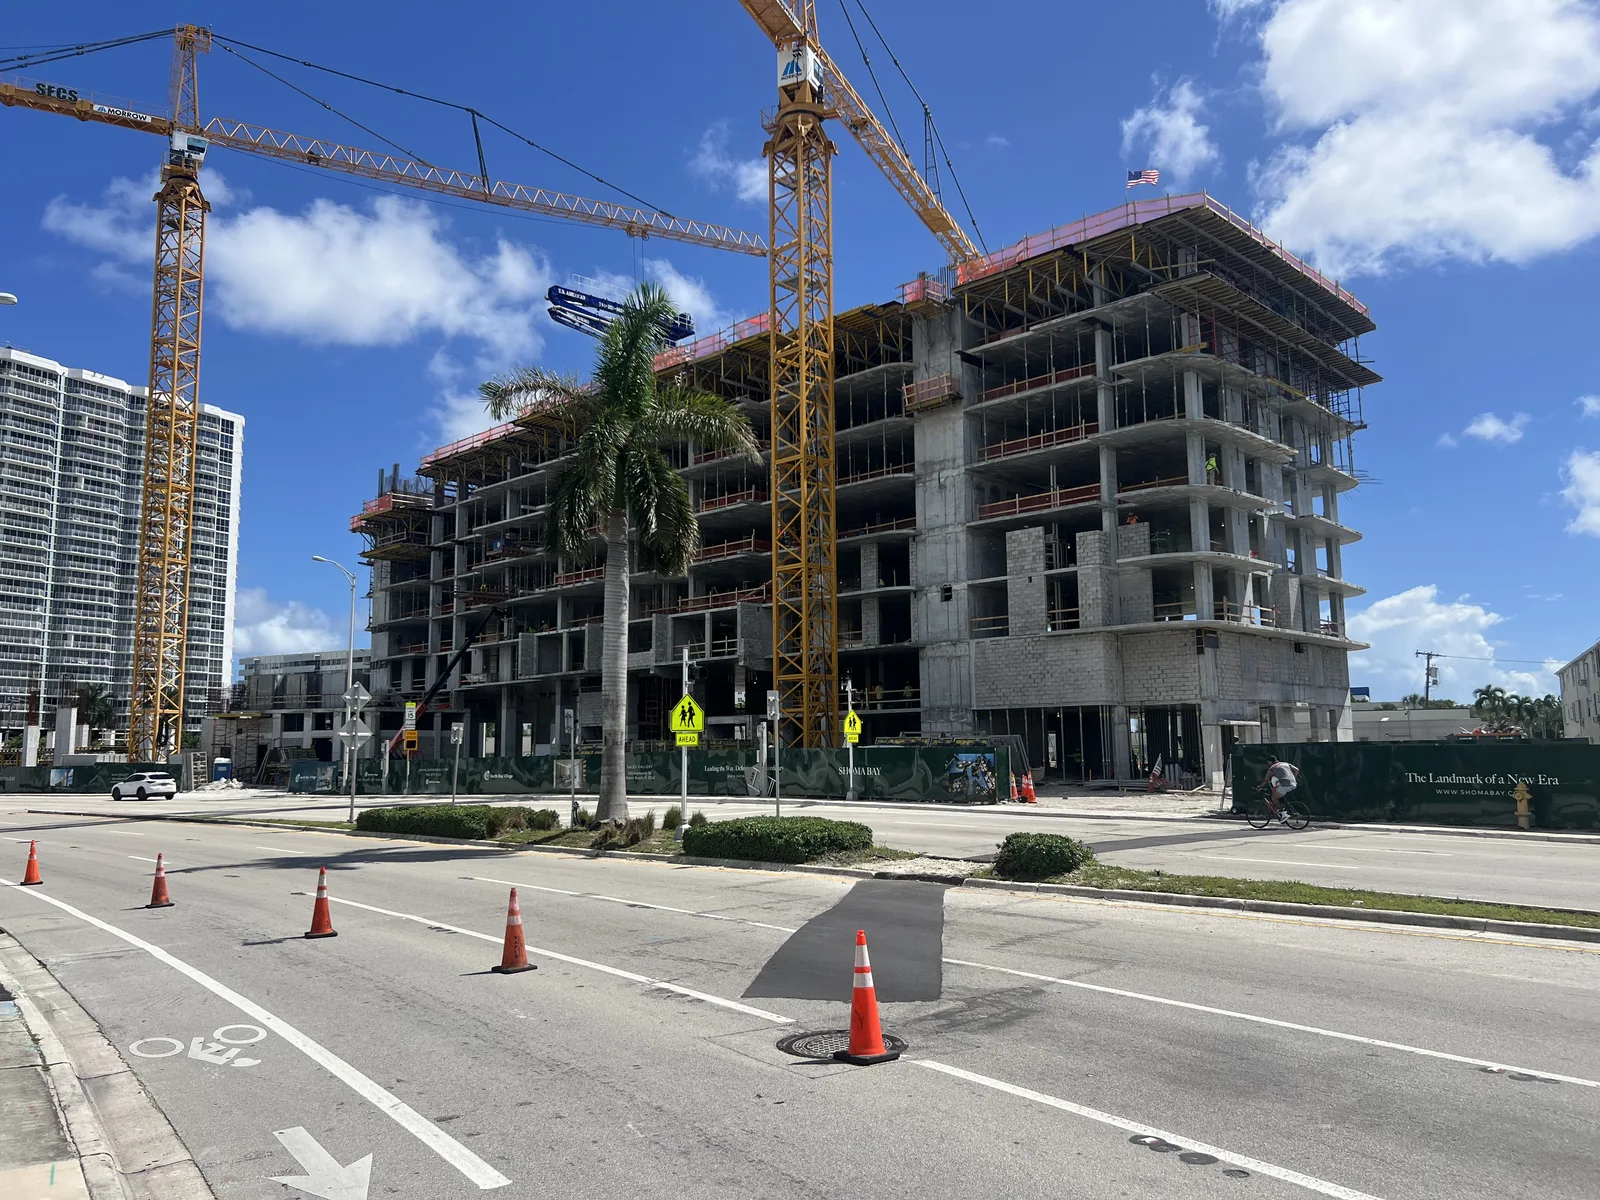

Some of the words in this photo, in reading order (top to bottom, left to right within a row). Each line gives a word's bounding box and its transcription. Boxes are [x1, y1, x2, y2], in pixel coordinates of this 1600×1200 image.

[108, 108, 148, 121] MORROW
[679, 735, 697, 743] AHEAD
[866, 766, 882, 776] BAY
[1405, 772, 1427, 783] The
[1429, 772, 1484, 785] Landmark
[1484, 774, 1498, 785] of
[1498, 776, 1505, 785] a
[1507, 774, 1536, 785] New
[1537, 774, 1560, 786] Era
